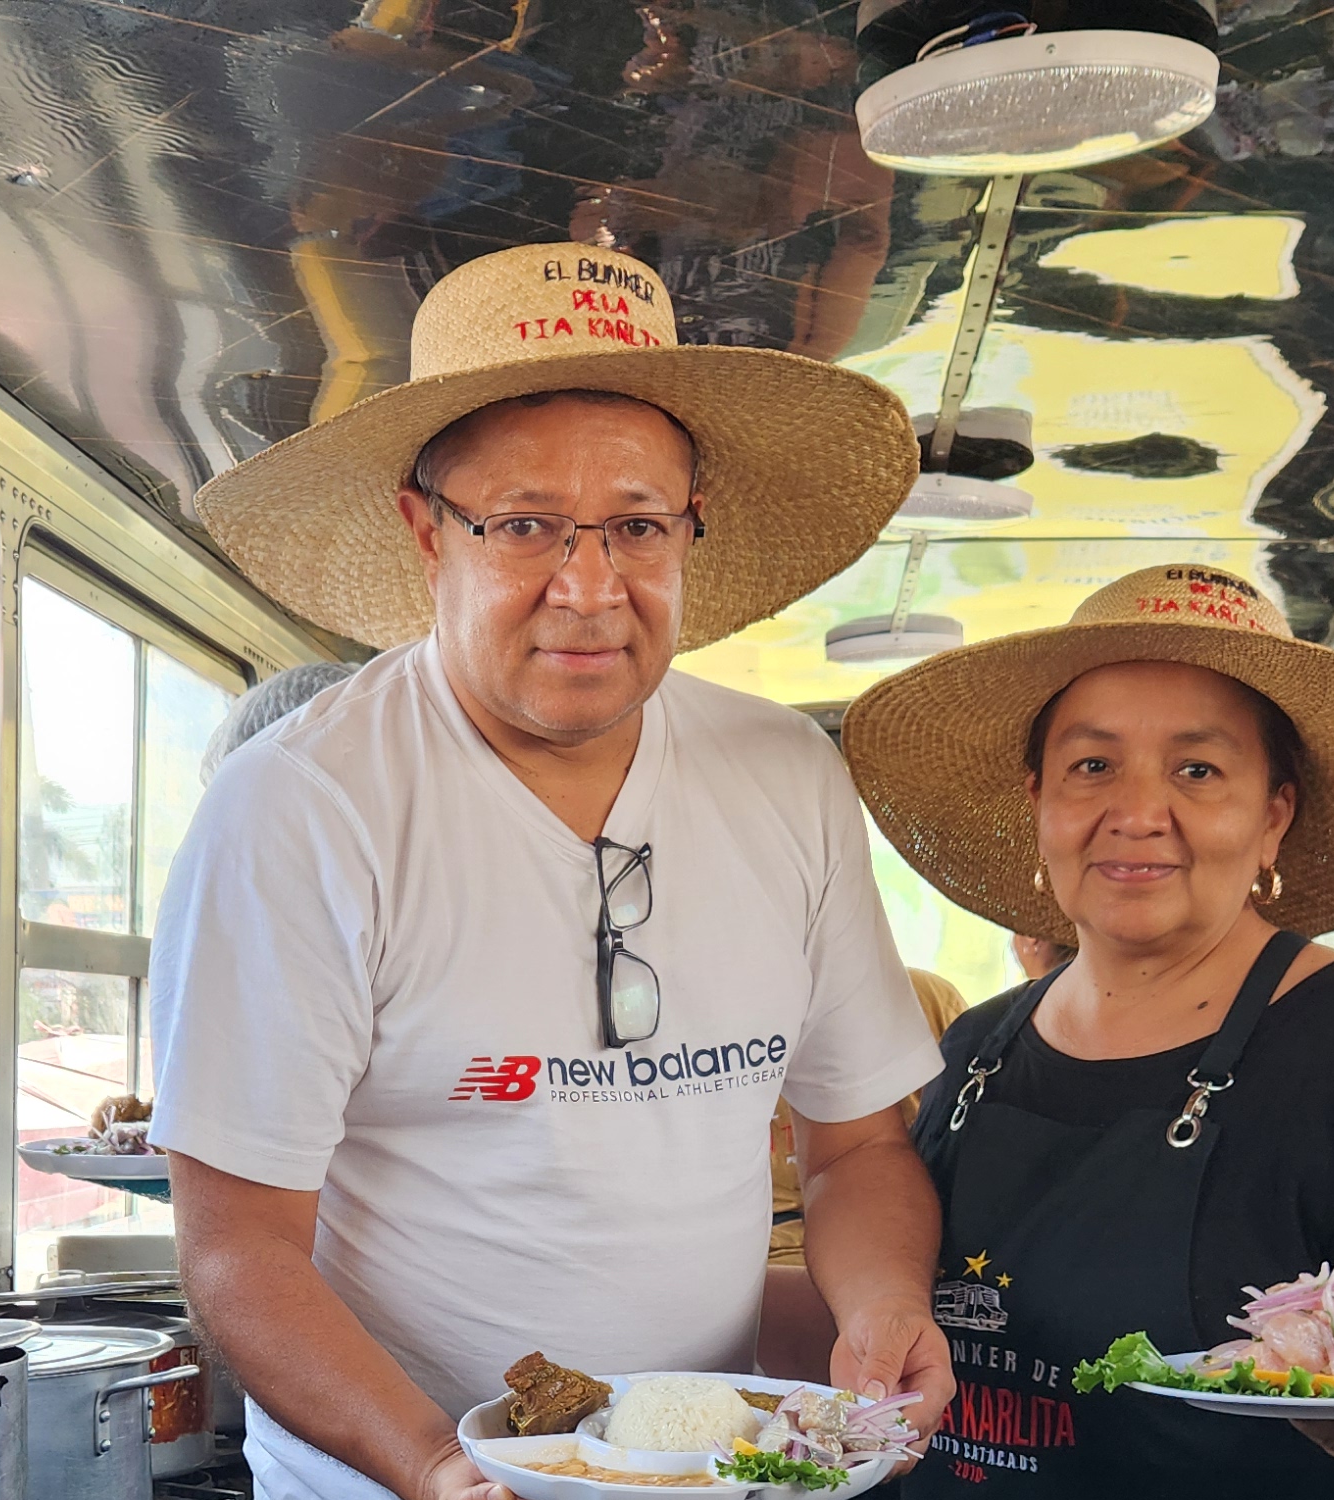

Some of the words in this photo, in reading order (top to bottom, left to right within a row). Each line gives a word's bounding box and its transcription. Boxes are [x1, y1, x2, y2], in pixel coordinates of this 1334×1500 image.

[544, 260, 571, 281] EL
[578, 258, 654, 308] BUNKER
[513, 316, 574, 341] TIA
[1135, 597, 1180, 614] TIA
[547, 1057, 616, 1087] new
[625, 1034, 787, 1087] balance
[551, 1087, 670, 1103] PROFESSIONAL
[676, 1076, 749, 1098] ATHLETIC
[752, 1066, 785, 1085] GEAR
[952, 1339, 1017, 1373] NKER
[1031, 1358, 1061, 1389] DE
[939, 1401, 956, 1435] A
[959, 1380, 1076, 1448] KARLITA
[931, 1434, 960, 1455] RITO
[963, 1442, 1039, 1474] CATACAOS
